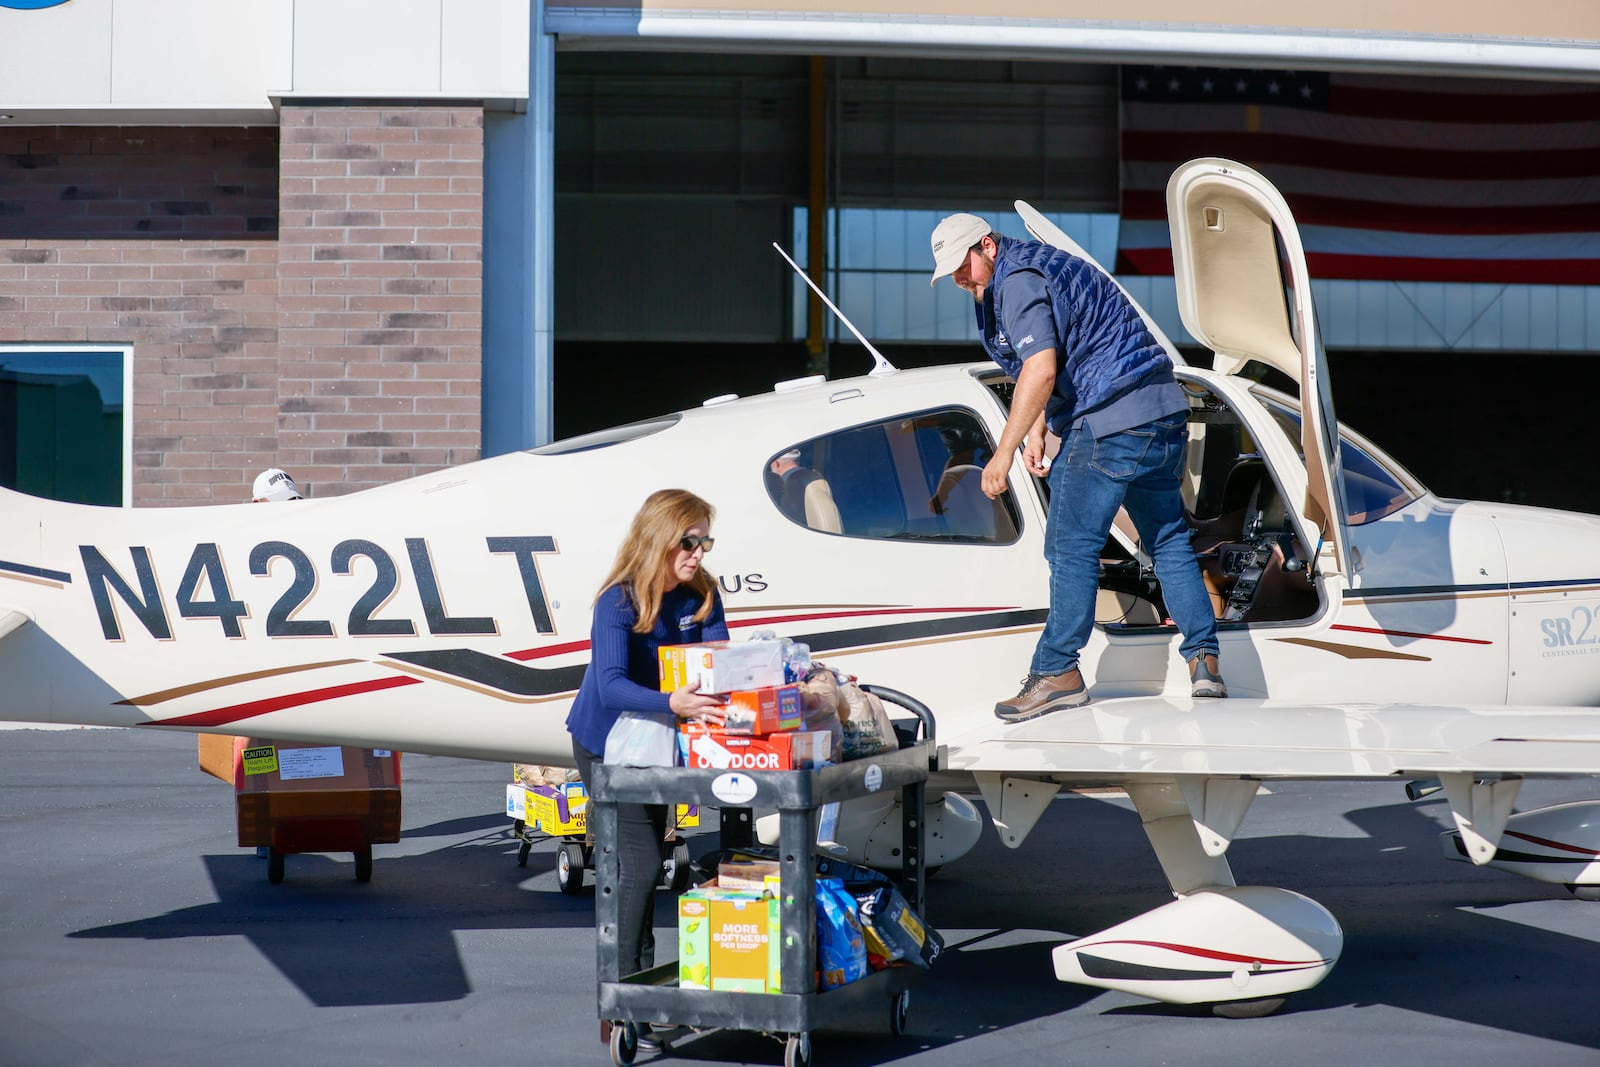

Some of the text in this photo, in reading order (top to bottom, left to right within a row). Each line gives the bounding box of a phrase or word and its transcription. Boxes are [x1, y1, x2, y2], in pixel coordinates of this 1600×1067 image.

[78, 535, 559, 642] N422LT
[1540, 604, 1600, 648] SR2
[244, 749, 273, 759] CAUTION
[697, 752, 780, 769] ODOOR
[247, 764, 275, 772] Required
[722, 923, 759, 934] MORE
[712, 933, 769, 943] SOFTNESS
[720, 942, 736, 950] PER
